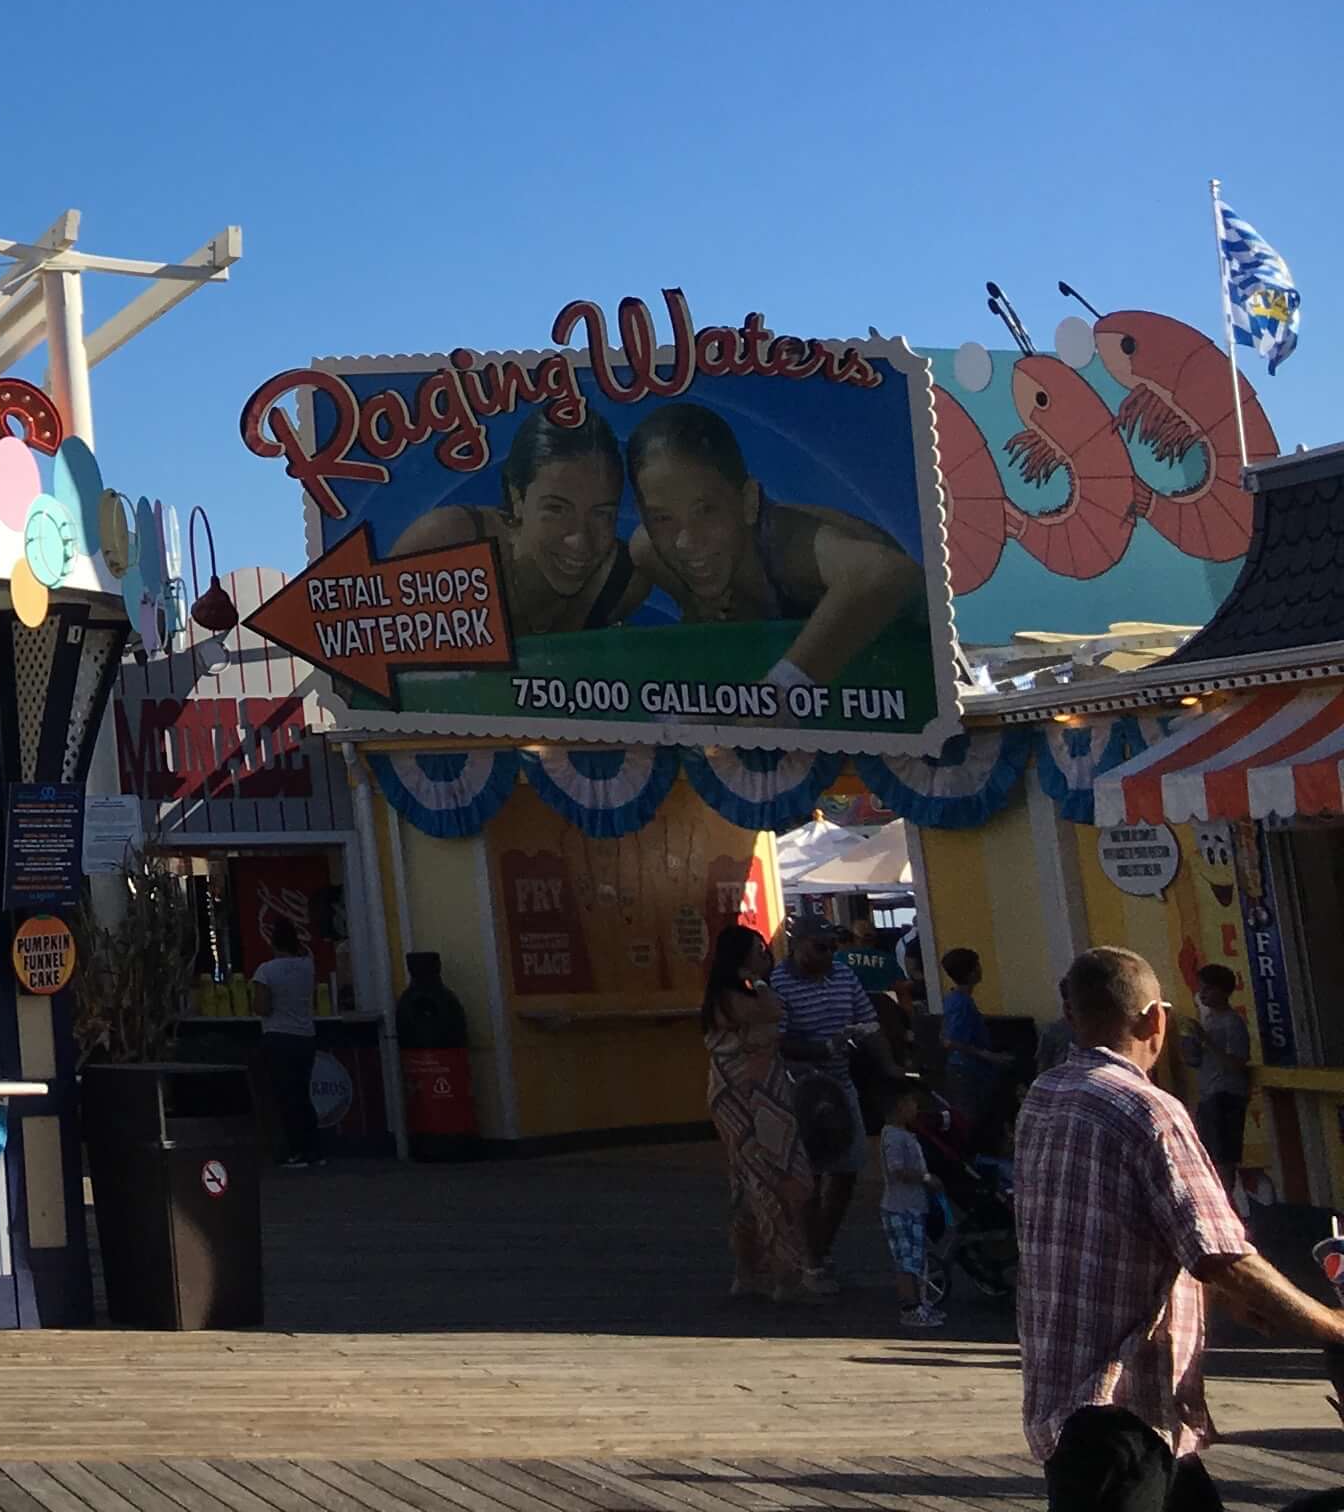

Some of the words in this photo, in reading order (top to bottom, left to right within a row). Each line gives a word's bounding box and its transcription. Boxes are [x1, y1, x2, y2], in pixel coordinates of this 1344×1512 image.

[240, 349, 588, 520] Raging
[550, 287, 883, 403] Waters
[308, 571, 392, 612] RETAIL
[398, 566, 490, 606] SHOPS
[315, 608, 495, 660] WATERPARK
[513, 677, 630, 715] 750,000
[640, 680, 778, 717] GALLONS
[789, 685, 833, 718] OF
[841, 688, 907, 721] FUN
[16, 933, 71, 955] PUMPKIN
[23, 952, 66, 972] FUNNEL
[847, 953, 886, 968] STAFF
[29, 970, 61, 989] CAKE
[1256, 932, 1287, 1048] FRIES
